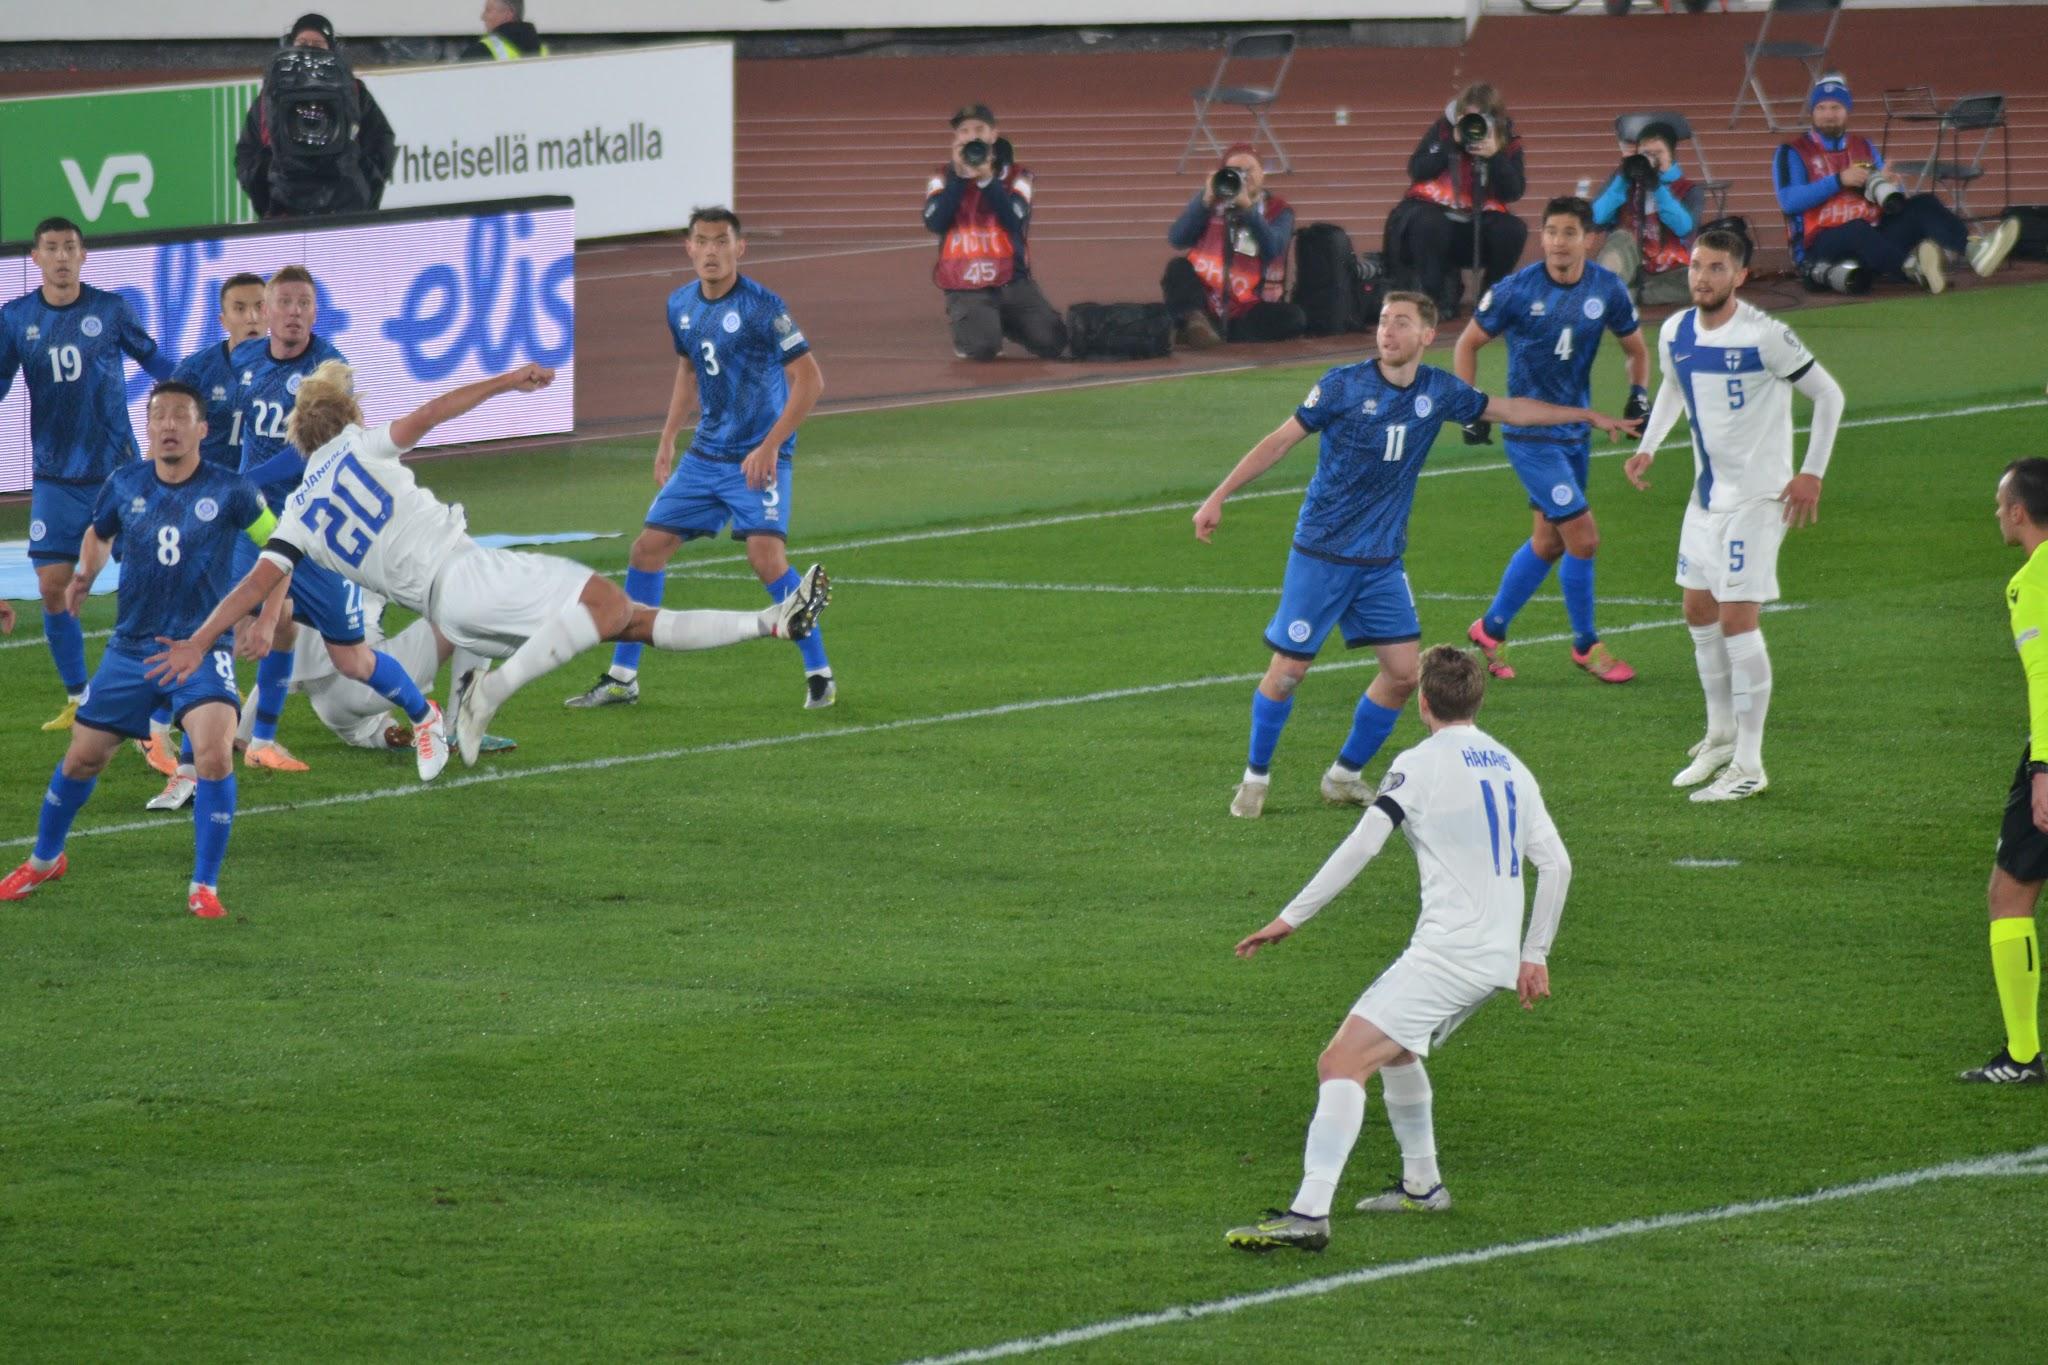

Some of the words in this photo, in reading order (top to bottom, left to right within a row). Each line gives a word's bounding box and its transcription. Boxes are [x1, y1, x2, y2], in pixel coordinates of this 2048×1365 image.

[537, 122, 663, 171] matkalla
[60, 153, 155, 223] VR
[963, 261, 997, 285] 45
[380, 211, 575, 385] elis
[701, 342, 720, 376] 3
[1554, 328, 1573, 361] 4
[48, 345, 83, 383] 19
[1726, 379, 1745, 410] 5
[229, 410, 244, 446] 1
[252, 400, 286, 439] 22
[1383, 425, 1407, 461] 11
[300, 451, 394, 570] 20
[157, 525, 181, 566] 8
[1728, 540, 1745, 572] 5
[342, 579, 363, 615] 2
[214, 650, 235, 681] 8
[1461, 745, 1511, 771] HÅKANS
[1480, 779, 1520, 877] 11
